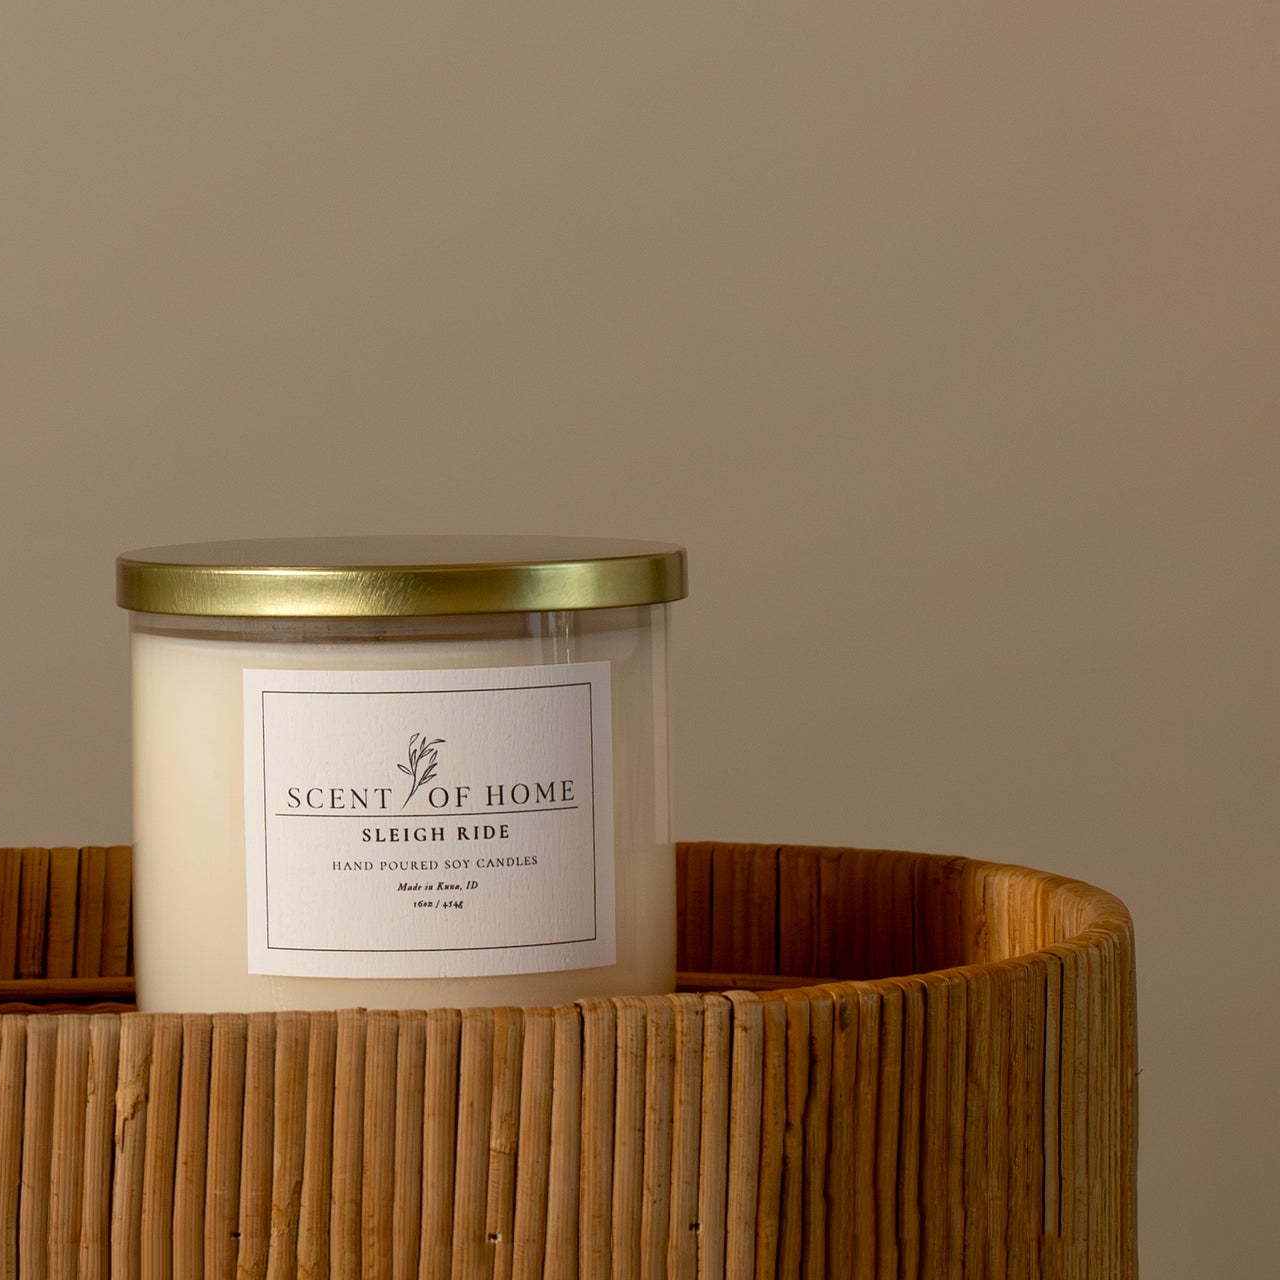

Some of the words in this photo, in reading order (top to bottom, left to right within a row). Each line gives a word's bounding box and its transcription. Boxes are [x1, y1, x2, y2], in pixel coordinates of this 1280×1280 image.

[287, 787, 392, 809] SCENT
[428, 786, 471, 809] OF
[486, 780, 575, 806] HOME
[362, 827, 445, 843] SLEIGH
[457, 824, 509, 841] RIDE
[332, 861, 374, 871] HAND
[380, 860, 439, 871] POURED
[444, 859, 470, 870] SOY
[476, 855, 538, 869] CANDLES
[397, 882, 422, 892] Made
[424, 882, 434, 891] in
[436, 881, 463, 891] Kuna,
[465, 880, 479, 890] ID
